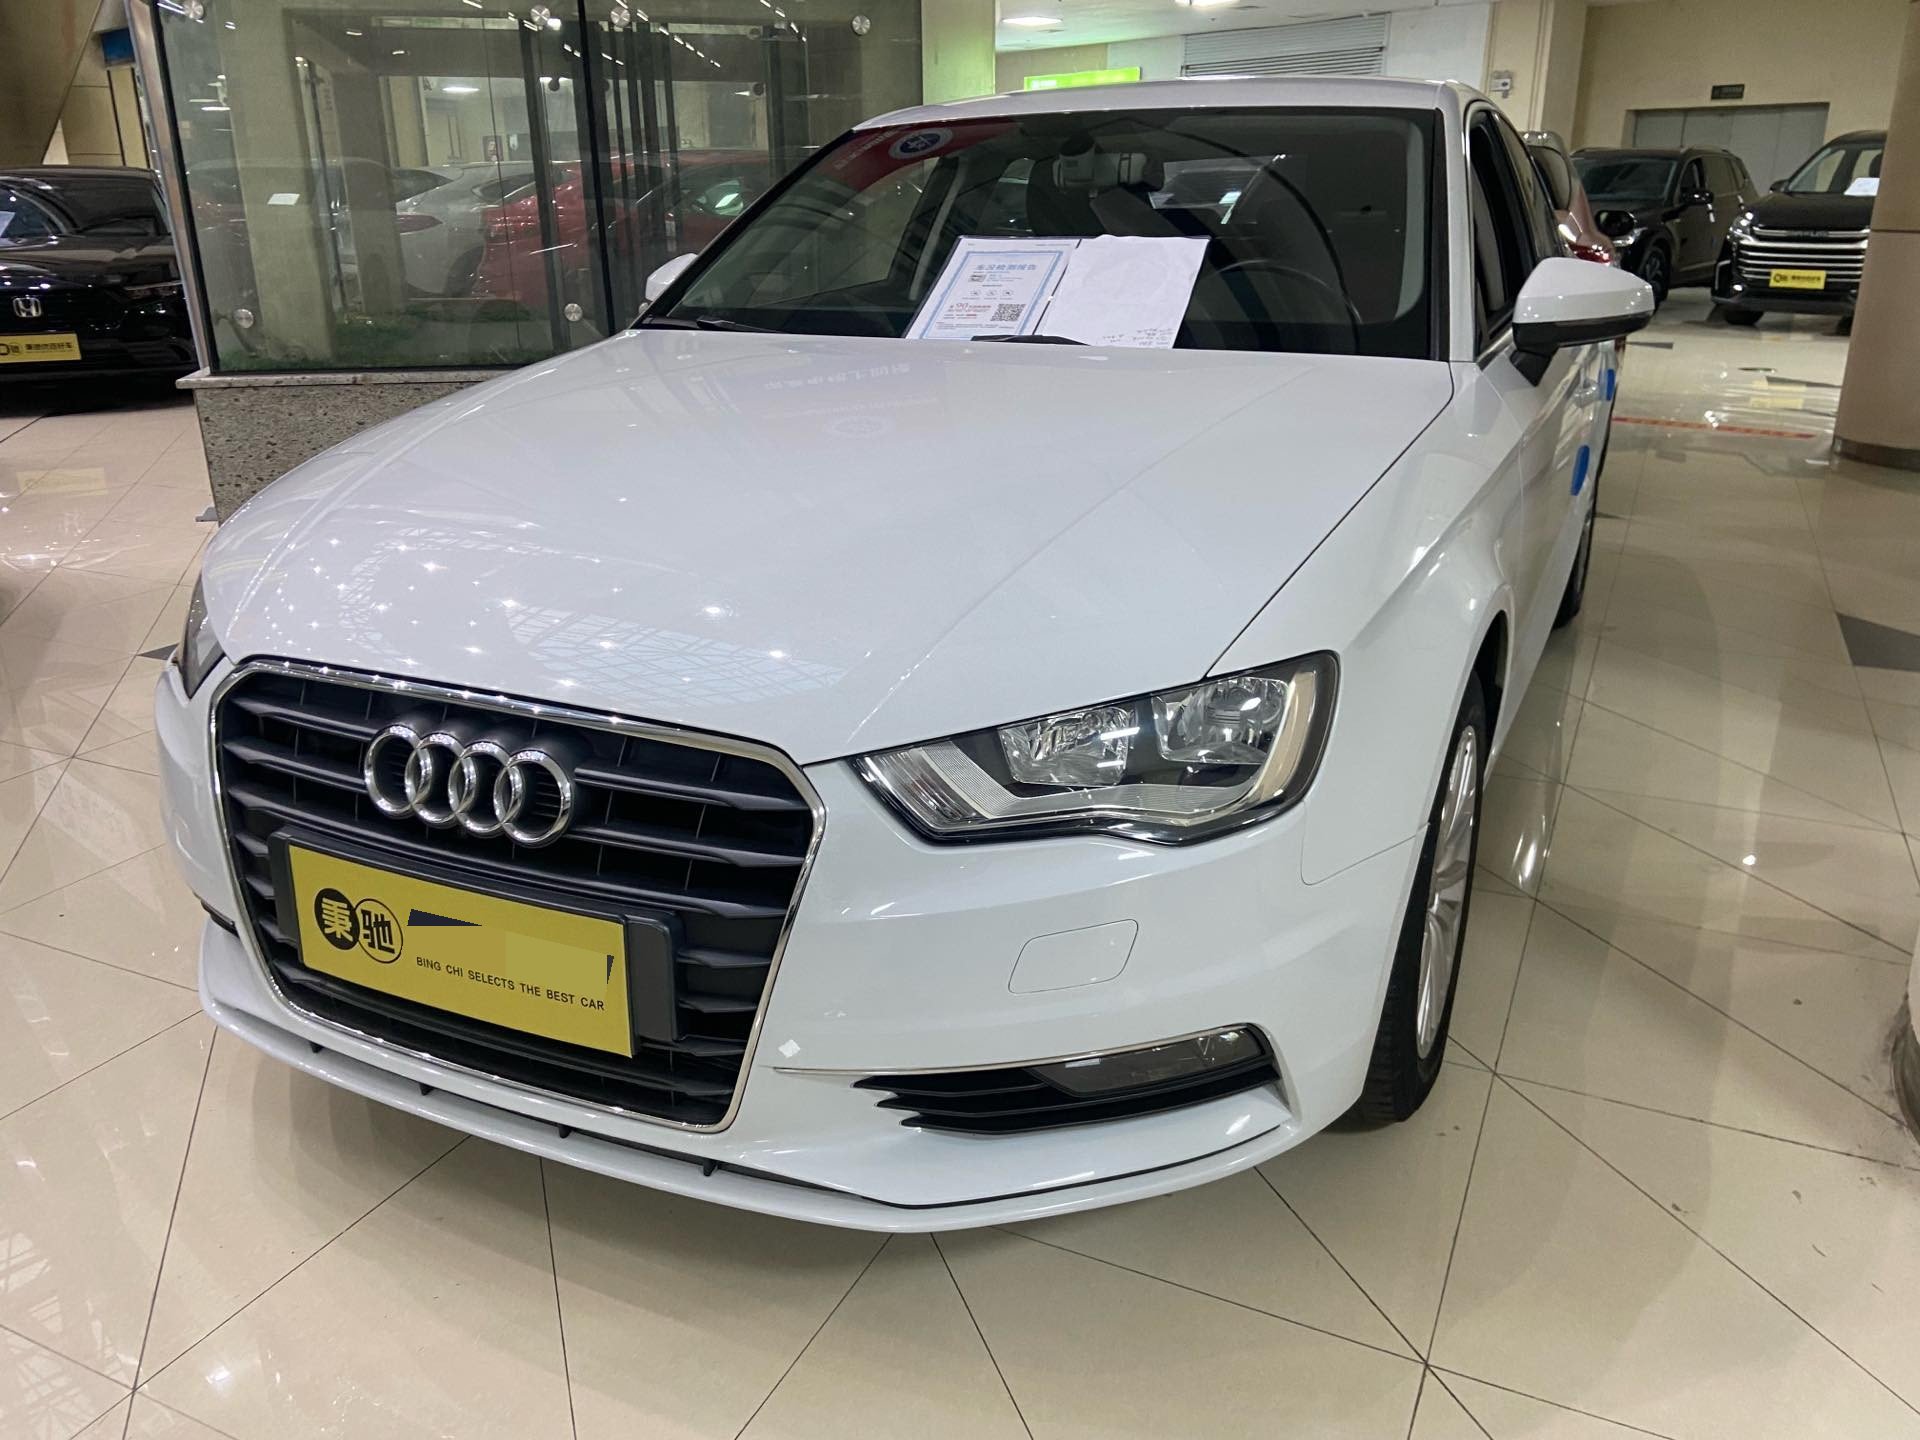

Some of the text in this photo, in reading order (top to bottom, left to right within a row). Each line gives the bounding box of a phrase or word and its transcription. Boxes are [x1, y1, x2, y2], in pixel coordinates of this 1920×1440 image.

[416, 956, 605, 1011] BING CHI SELECTS THE BEST CAR
